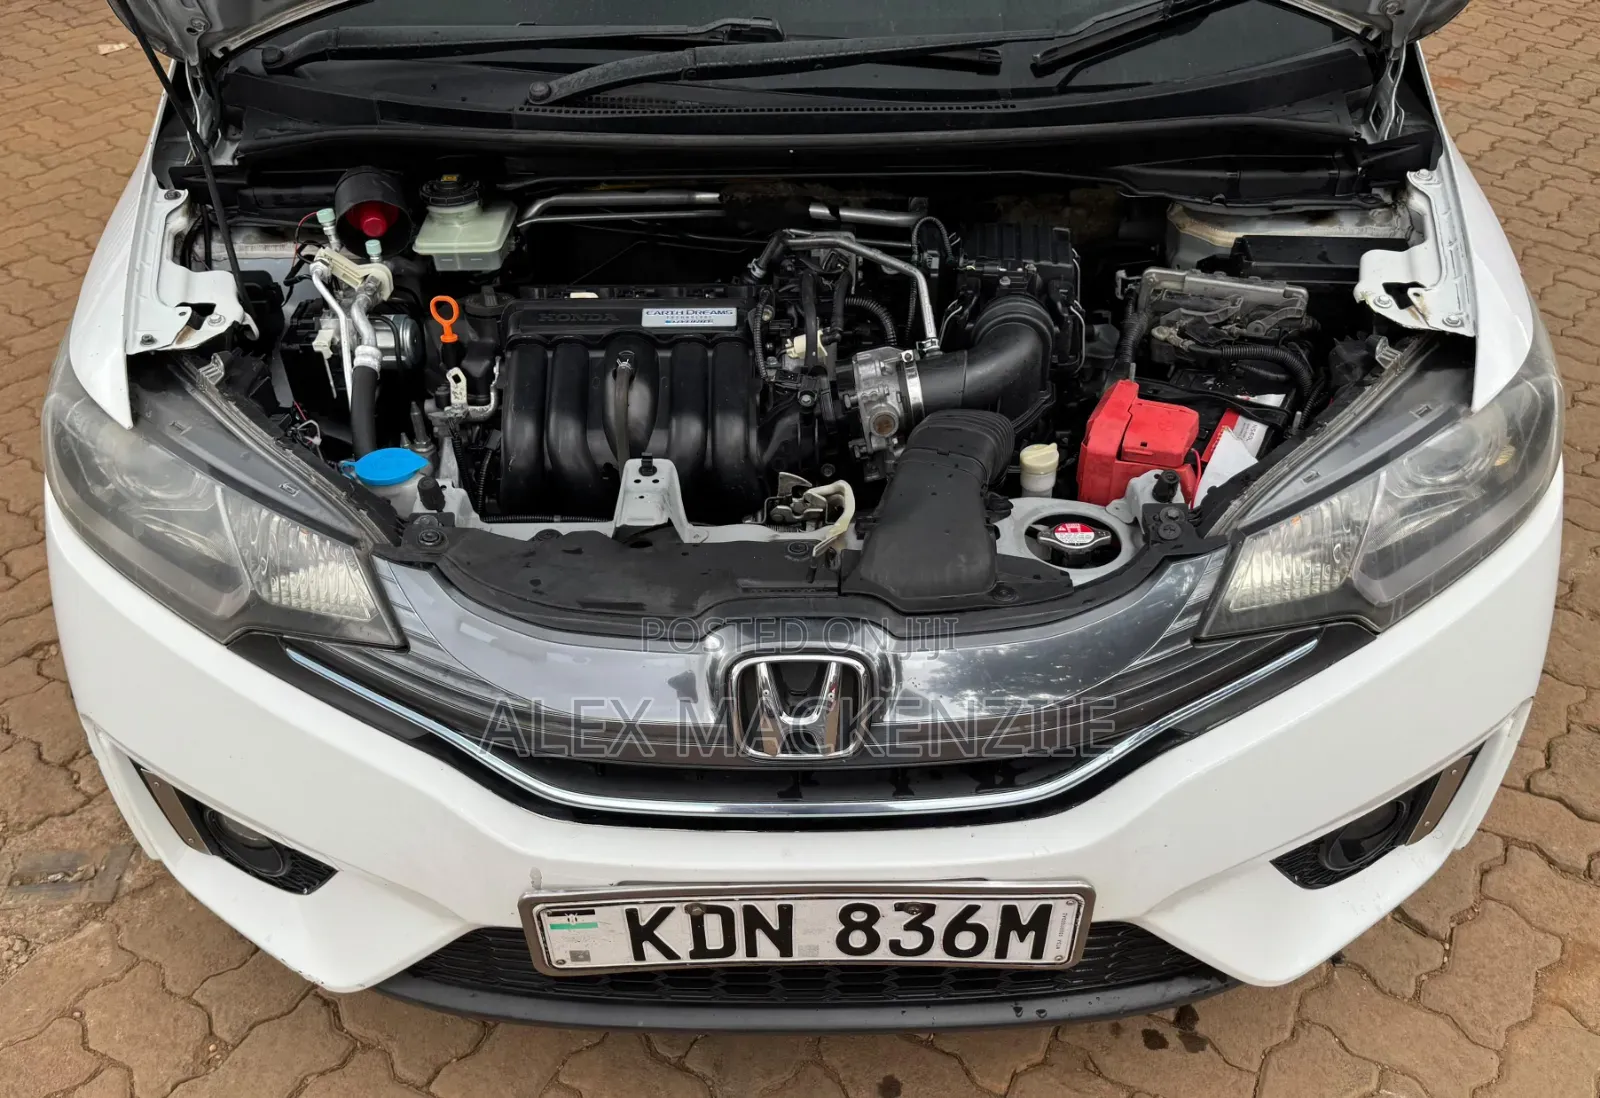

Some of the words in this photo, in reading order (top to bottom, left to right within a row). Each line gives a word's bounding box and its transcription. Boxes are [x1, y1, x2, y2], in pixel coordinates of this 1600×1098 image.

[538, 312, 619, 322] HONDA
[625, 903, 794, 961] KDN
[835, 901, 1053, 960] 836M
